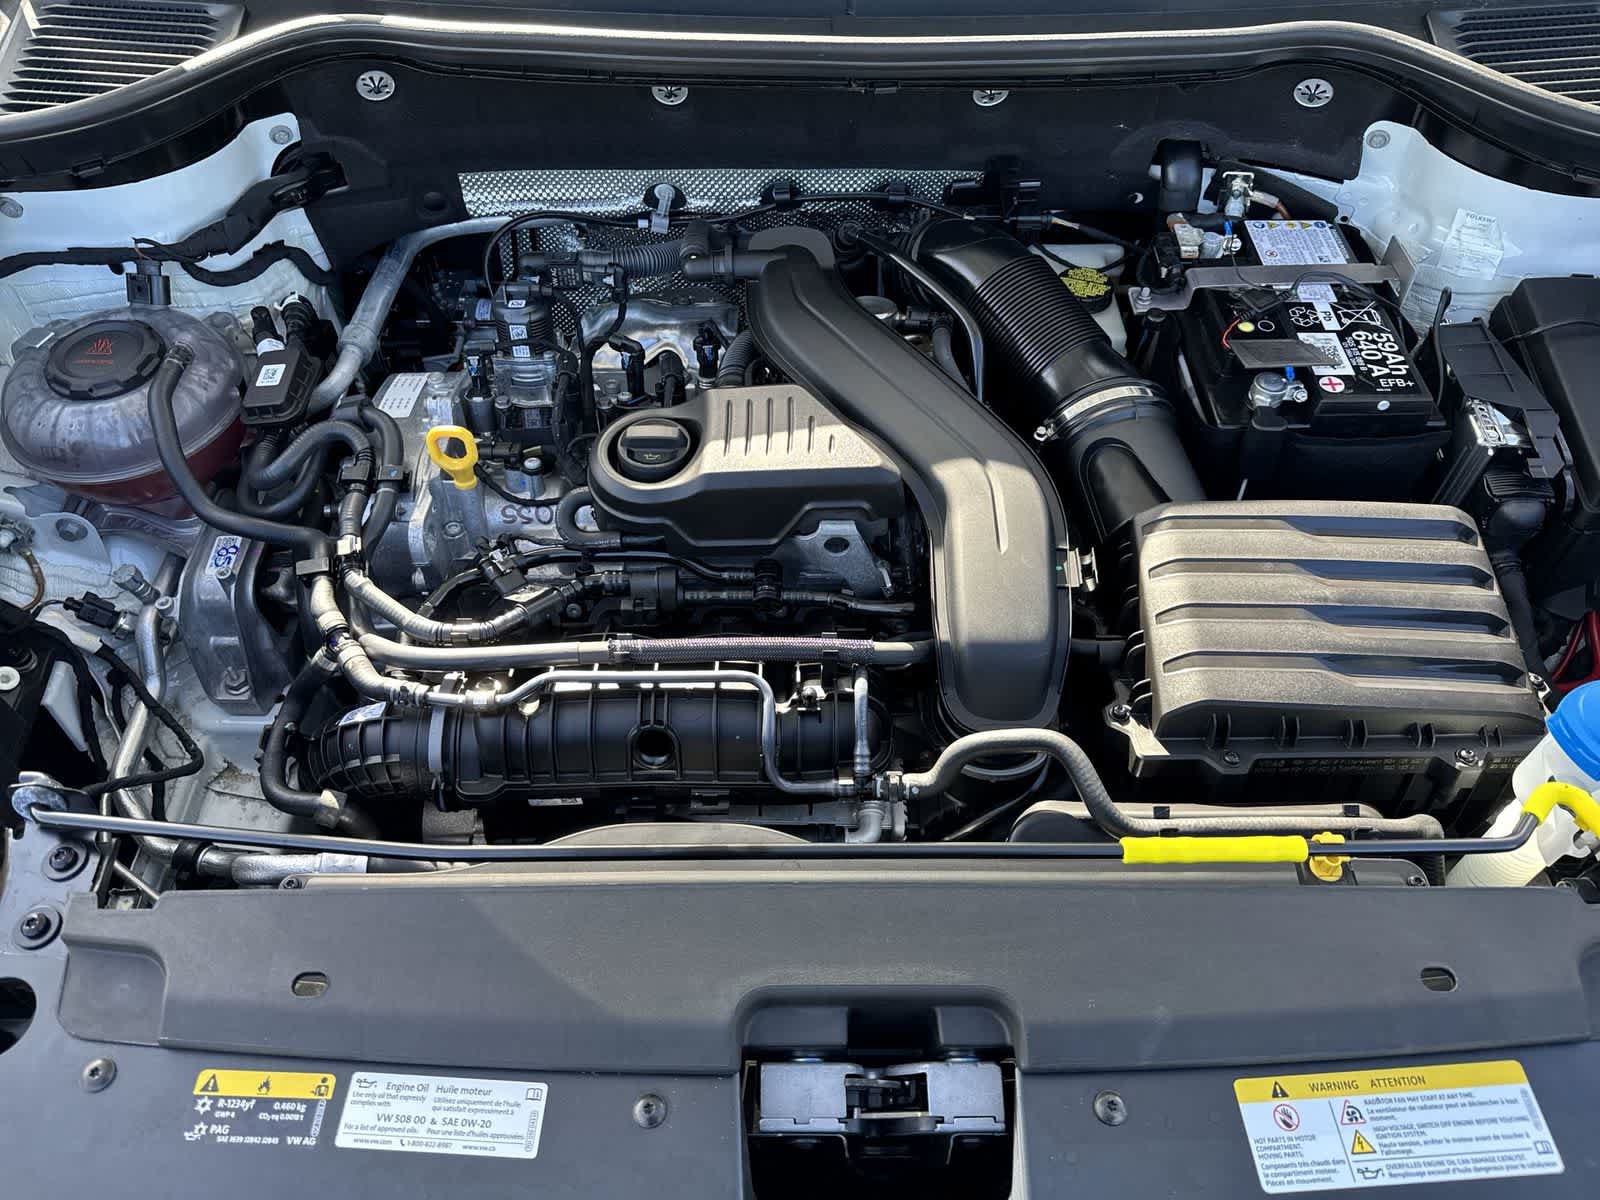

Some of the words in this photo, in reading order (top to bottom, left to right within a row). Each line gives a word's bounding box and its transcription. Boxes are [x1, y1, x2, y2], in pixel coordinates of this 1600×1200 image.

[1352, 331, 1383, 361] 640
[1373, 333, 1410, 376] 59Ah
[1366, 364, 1391, 377] A
[1380, 378, 1415, 388] EFB+
[386, 1082, 416, 1093] Engine
[416, 1084, 430, 1093] Oil
[436, 1085, 460, 1095] Huile
[460, 1087, 492, 1096] moteur
[1309, 1081, 1360, 1093] WARNING
[1369, 1076, 1427, 1089] ATTENTION
[216, 1099, 257, 1111] R-1234yf
[376, 1115, 395, 1123] VW
[413, 1117, 426, 1125] 00
[430, 1118, 438, 1126] &
[442, 1118, 459, 1127] SAE
[461, 1120, 492, 1129] 0W-20
[210, 1125, 231, 1135] PAG
[285, 1137, 303, 1145] VW
